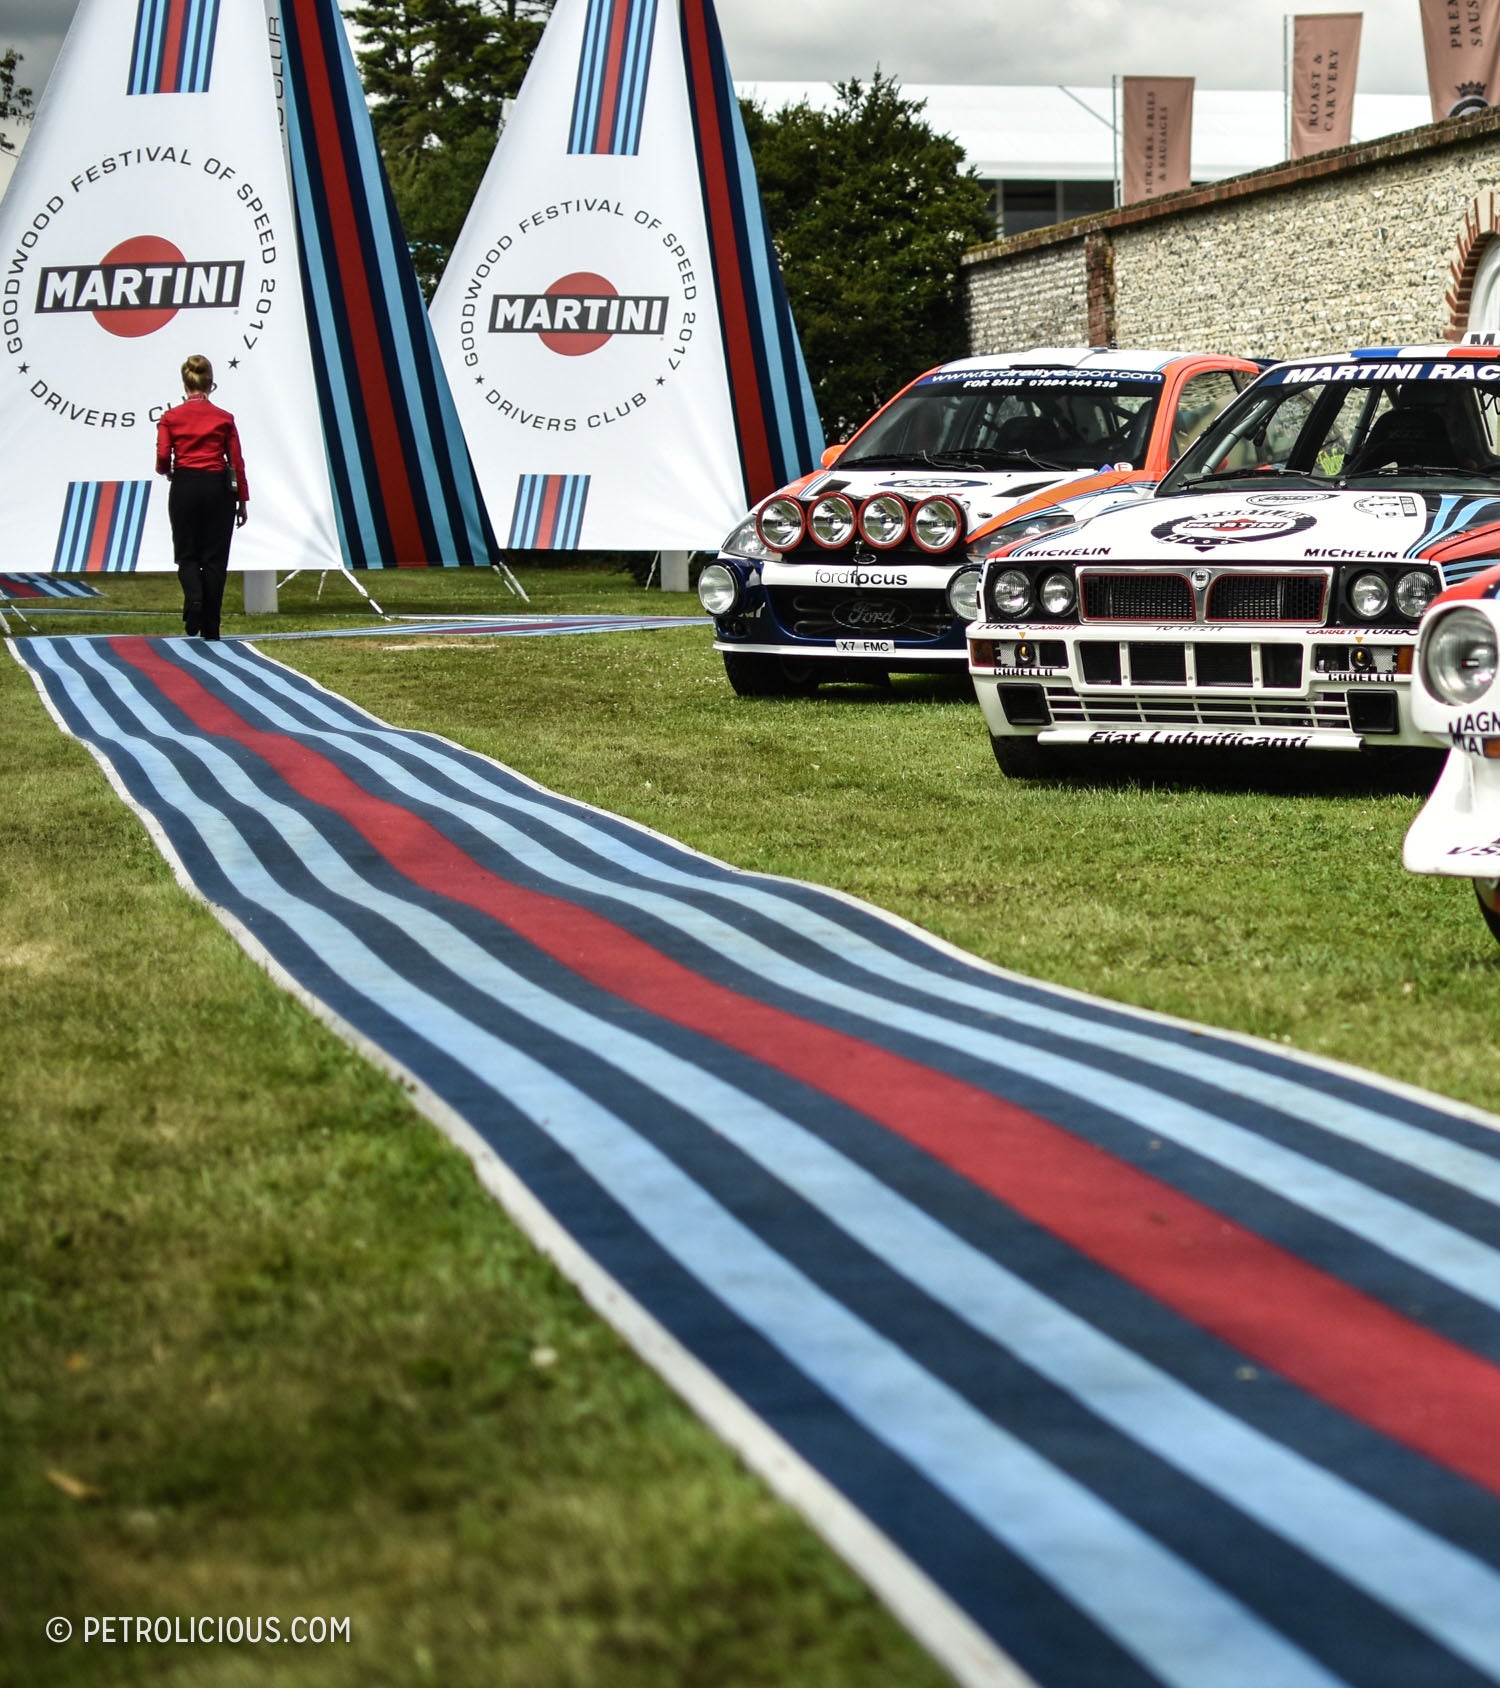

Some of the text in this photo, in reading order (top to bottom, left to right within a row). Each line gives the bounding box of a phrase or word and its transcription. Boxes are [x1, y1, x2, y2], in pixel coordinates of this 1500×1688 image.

[1309, 54, 1322, 127] ROAST &
[1324, 49, 1339, 132] CARVERY
[1159, 106, 1168, 168] SAUSAGES
[3, 146, 277, 354] GOODWOOD FESTIVAL OF SPEED 2017
[42, 265, 238, 309] MARTINI
[461, 198, 697, 370] GOODWOOD FESTIVAL OF SPEED 2017
[494, 298, 662, 331] MARTINI
[931, 369, 1162, 382] www.fordrallyesport.com
[963, 379, 989, 389] FOR
[991, 378, 1024, 387] SALE
[1282, 363, 1422, 385] MARTINI
[30, 379, 136, 428] DRIVERS
[485, 389, 647, 431] DRIVERS CLUB
[1025, 547, 1111, 557] MICHELIN
[1304, 548, 1398, 559] MICHELIN
[849, 604, 895, 623] Ford
[840, 641, 890, 652] X7 FMC
[1088, 730, 1313, 748] Fiat Lubrificanti
